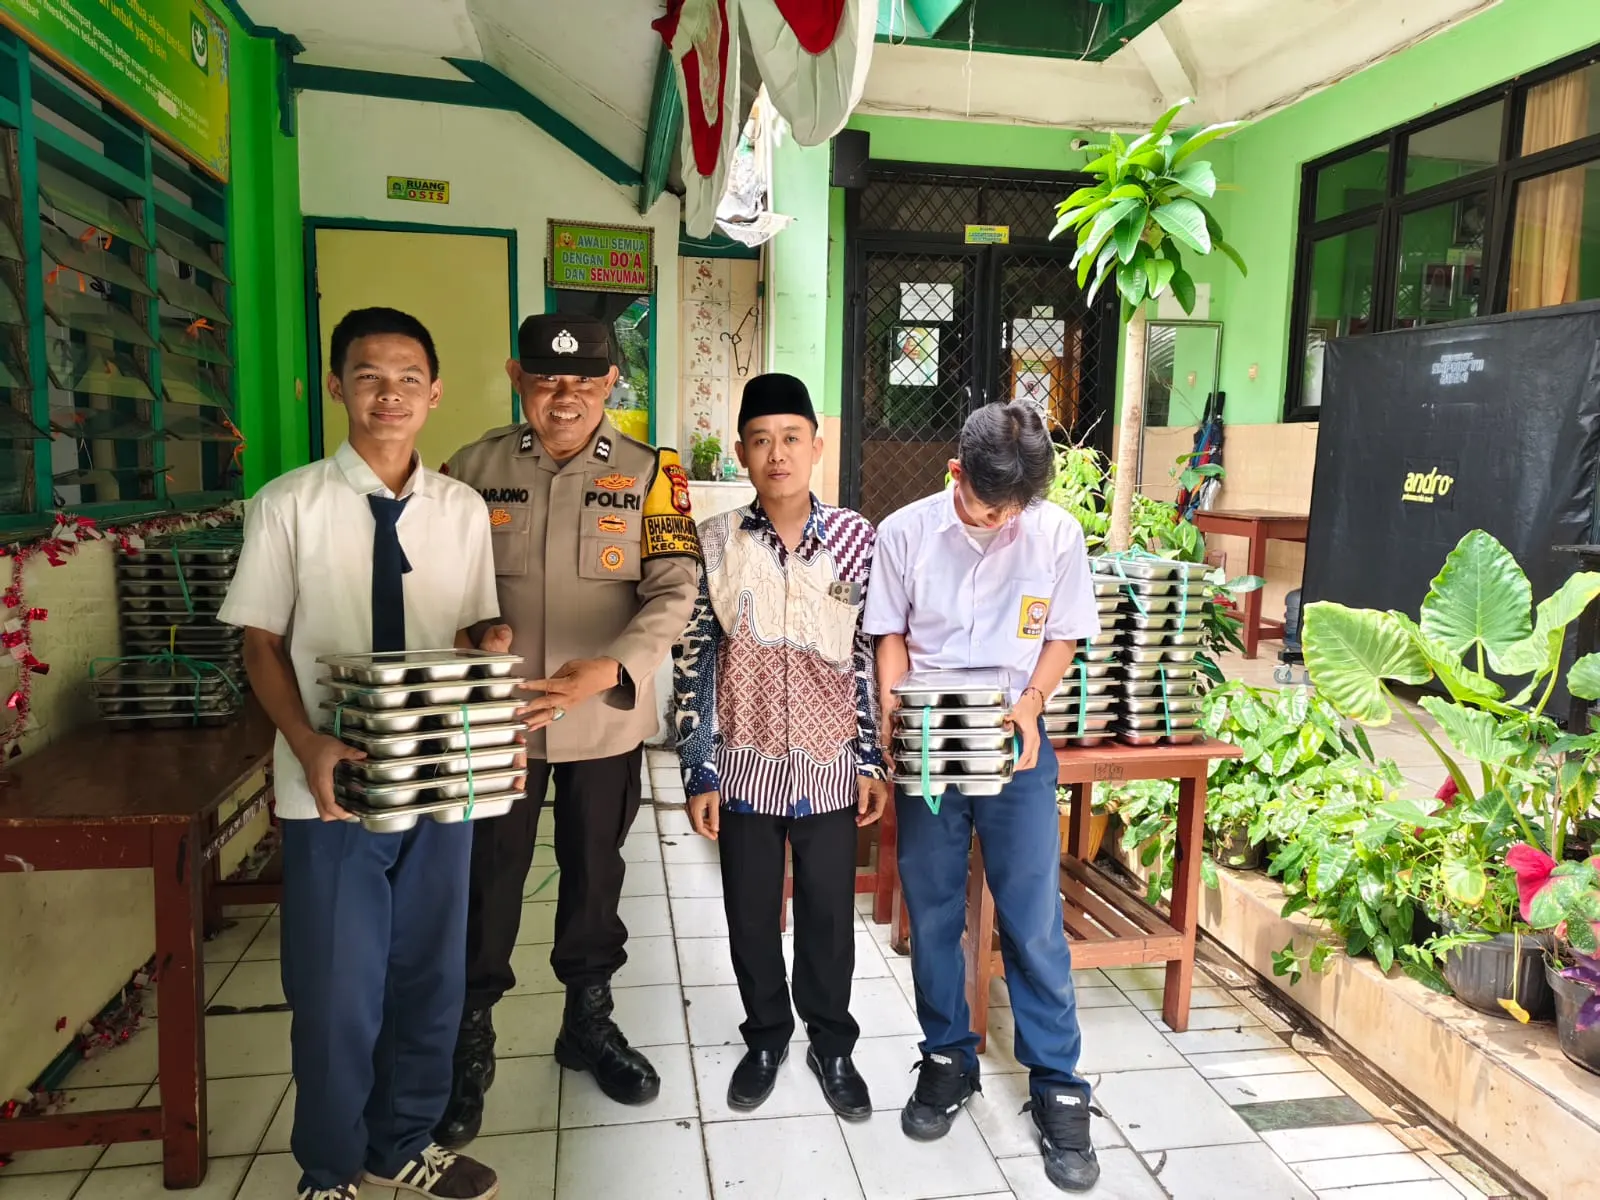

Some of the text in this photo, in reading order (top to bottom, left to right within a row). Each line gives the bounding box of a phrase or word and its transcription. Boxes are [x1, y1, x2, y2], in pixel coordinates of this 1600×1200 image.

[406, 180, 445, 191] RUANG
[408, 189, 444, 201] OSIS
[578, 235, 645, 252] AWALI SEMUA
[562, 251, 642, 269] DENGAN DO'A
[565, 267, 645, 284] DAN SENYUMAN
[585, 491, 640, 511] POLRI
[652, 543, 680, 552] KEC.
